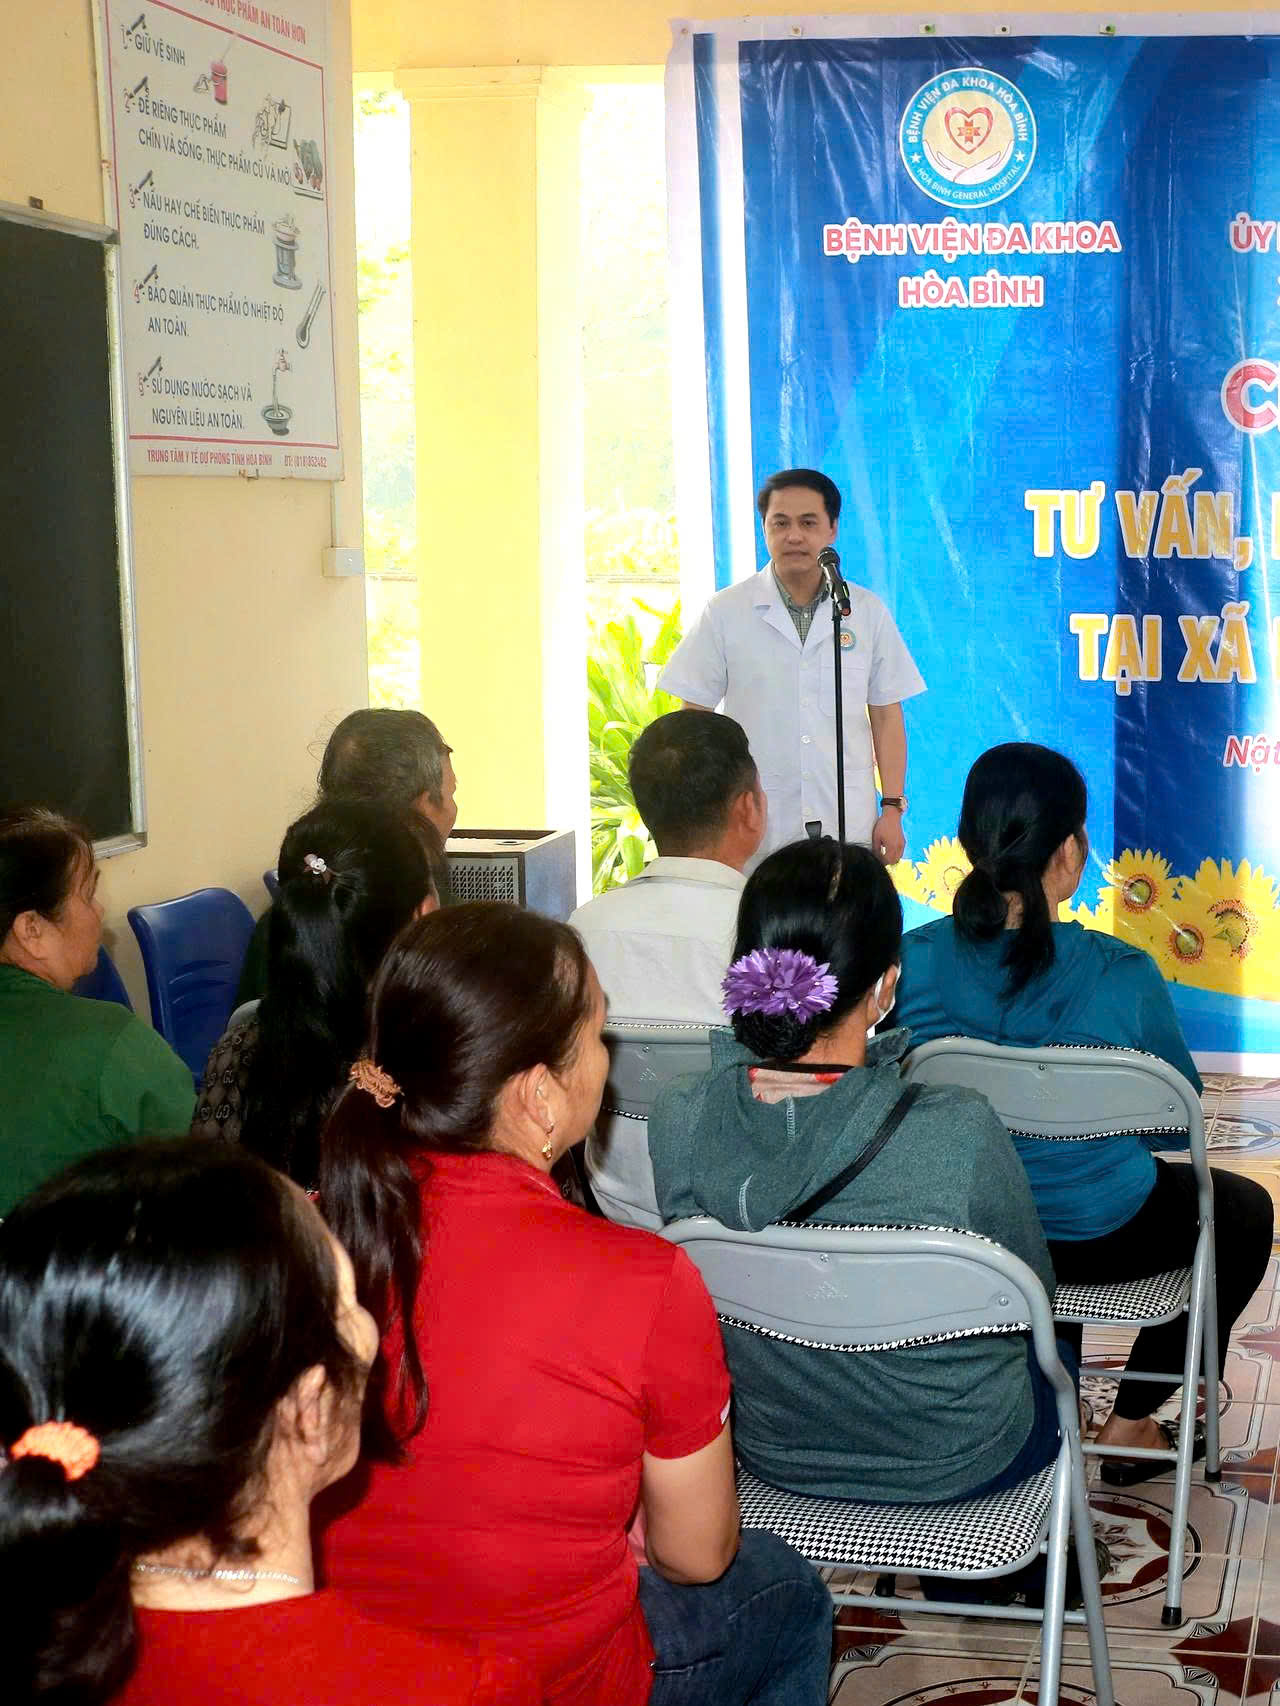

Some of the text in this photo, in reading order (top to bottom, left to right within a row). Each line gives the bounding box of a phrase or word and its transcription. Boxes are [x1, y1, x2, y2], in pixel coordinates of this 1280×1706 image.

[260, 10, 271, 30] AN
[166, 45, 185, 65] SINH
[907, 77, 1029, 144] BỆNH VIỆN ĐA KHOA HÒA BÌNH
[951, 189, 989, 200] GENERAL
[989, 166, 1021, 194] HOSPITAL
[164, 197, 181, 216] HAY
[825, 220, 1120, 260] BỆNH VIỆN ĐA KHOA
[1232, 216, 1273, 250] ỦY
[902, 272, 1041, 305] HÒA BÌNH
[148, 317, 161, 333] AN
[152, 406, 187, 425] NGUYÊN
[189, 407, 205, 431] LIỆU
[207, 413, 219, 428] AN
[148, 450, 168, 463] TRUNG
[1025, 481, 1104, 558] TƯ
[1115, 468, 1253, 571] VẤN,
[1070, 613, 1162, 696] TẠI
[1178, 602, 1256, 684] XÃ
